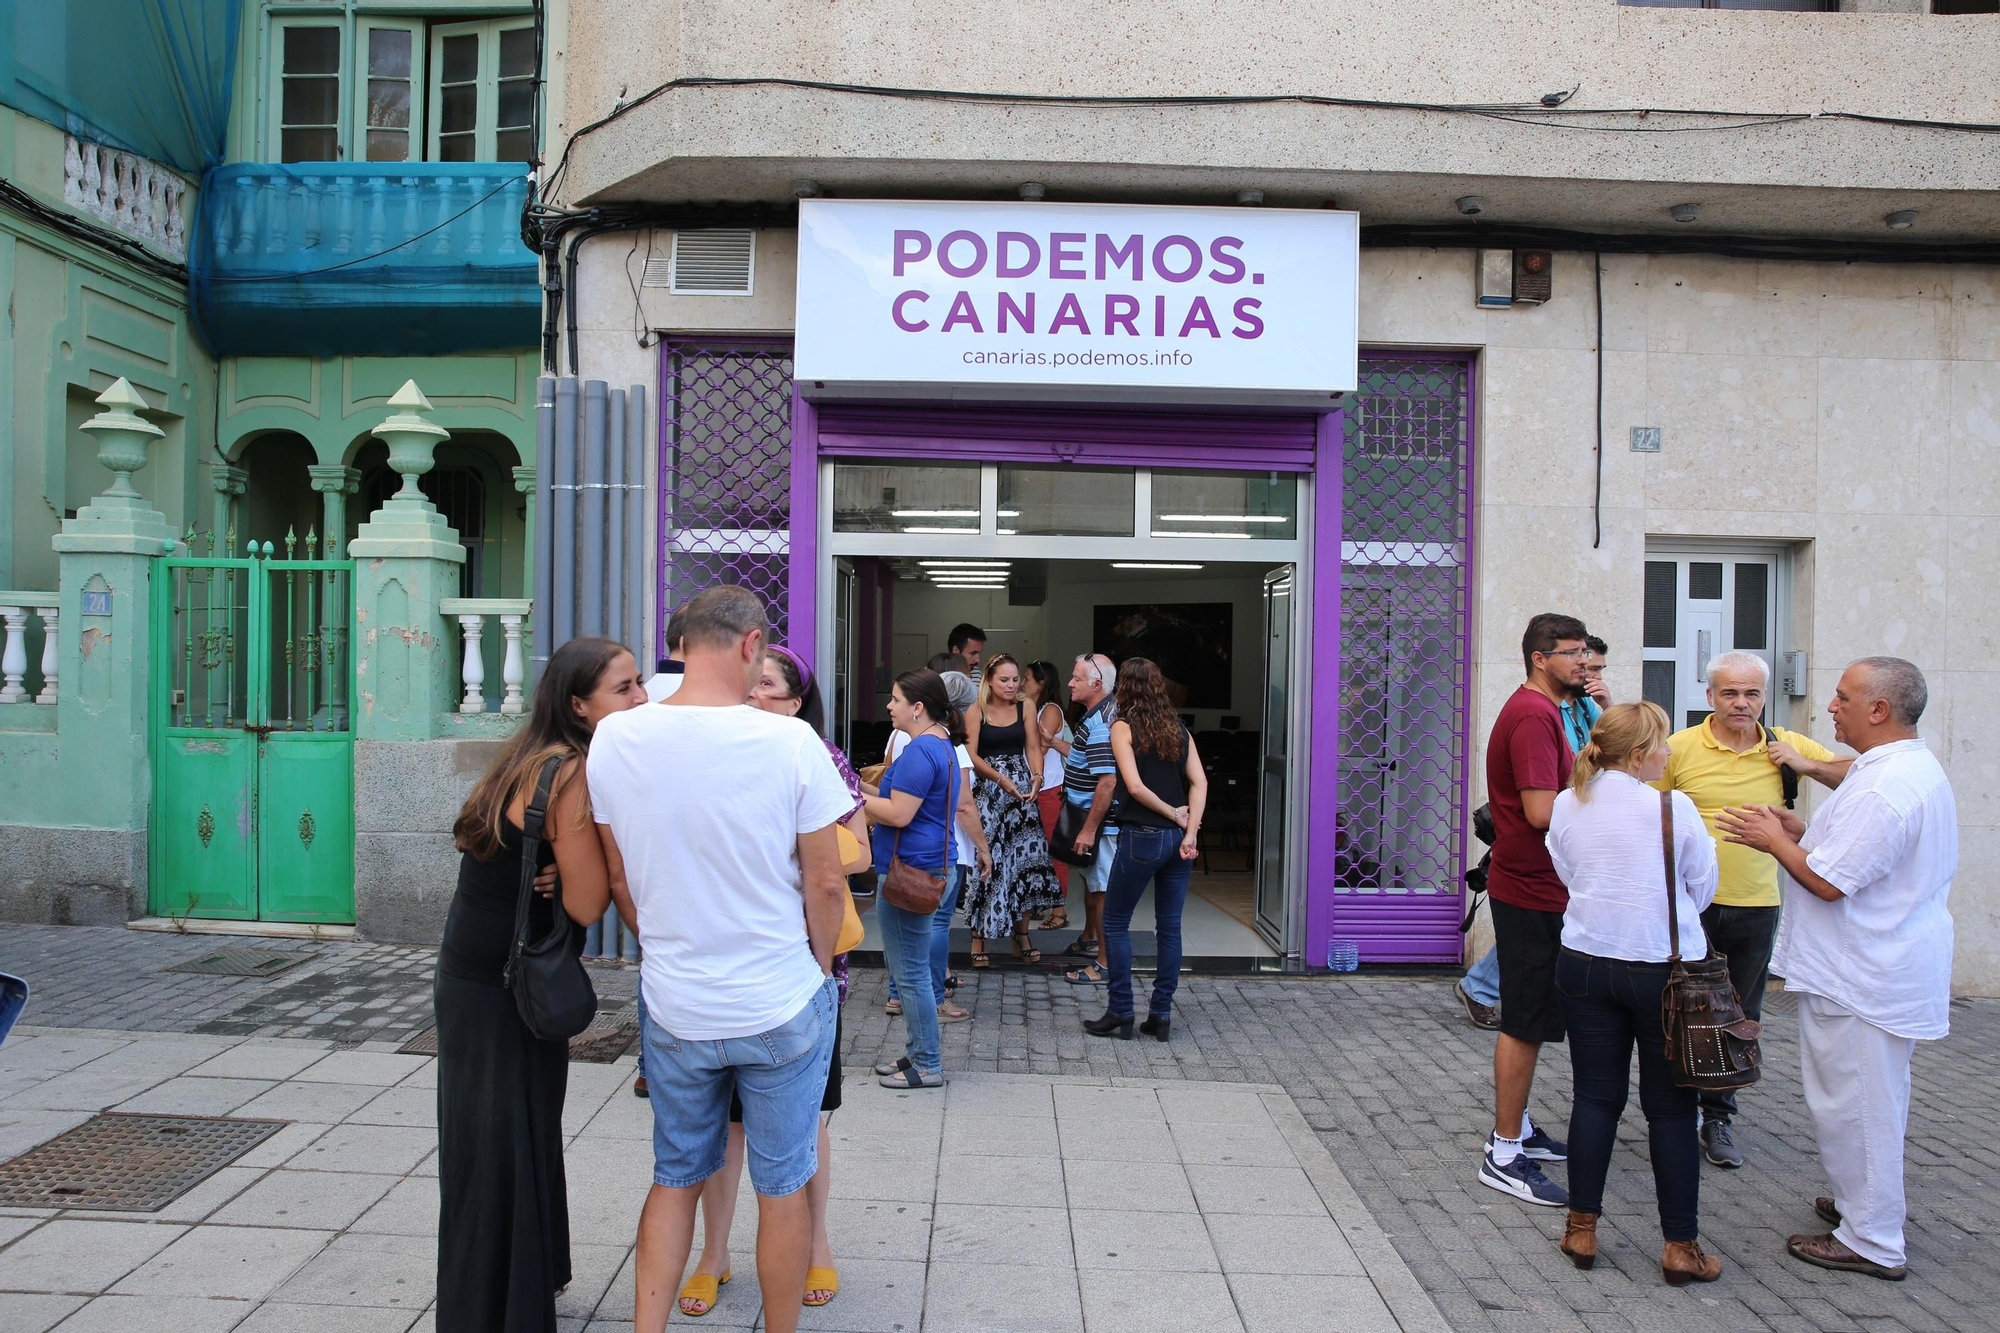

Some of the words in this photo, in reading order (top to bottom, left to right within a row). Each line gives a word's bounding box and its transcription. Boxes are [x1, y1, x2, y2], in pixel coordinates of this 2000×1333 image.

[892, 229, 1265, 285] PODEMOS.
[891, 289, 1265, 340] CANARIAS
[962, 348, 1193, 368] canarias.podemos.info
[1638, 430, 1654, 449] 22
[89, 593, 106, 612] 24
